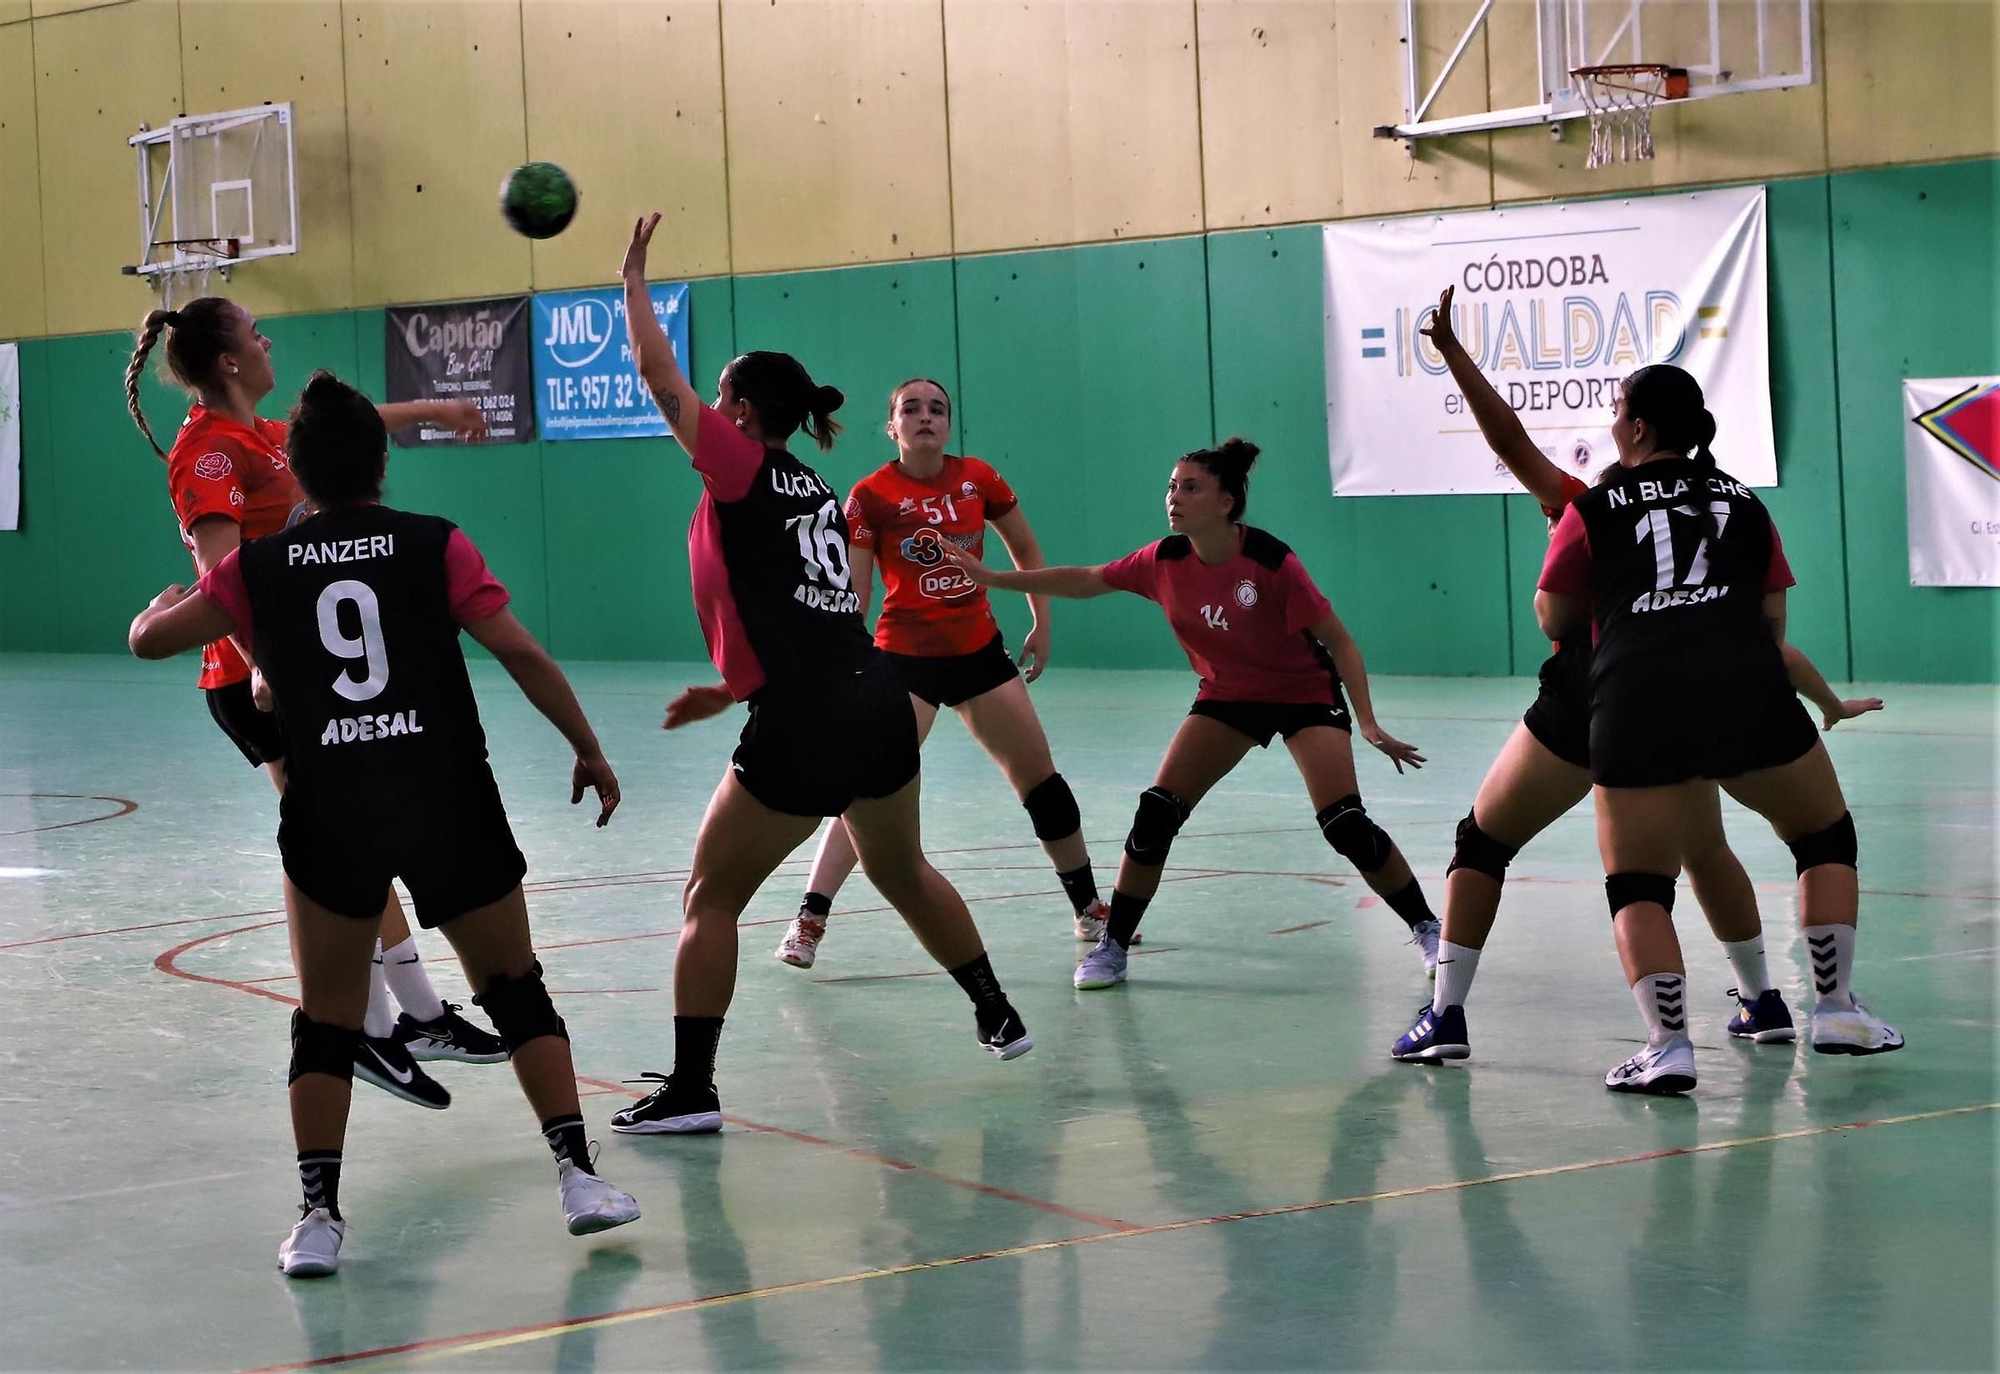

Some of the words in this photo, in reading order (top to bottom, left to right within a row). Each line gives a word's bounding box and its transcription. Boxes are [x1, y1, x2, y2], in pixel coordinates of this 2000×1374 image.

[1463, 253, 1609, 293] CÓRDOBA
[405, 309, 503, 358] Capitão
[545, 305, 603, 347] JML
[468, 350, 494, 380] Grill
[546, 378, 580, 411] TLF:
[582, 375, 609, 409] 957
[614, 374, 634, 408] 32
[1507, 377, 1624, 412] DEPORT
[921, 494, 957, 525] 51
[1607, 486, 1634, 509] N.
[1639, 478, 1752, 501] BLACHE
[287, 534, 394, 566] PANZERI
[784, 499, 850, 590] 16
[1634, 500, 1731, 592] 17
[1200, 604, 1229, 631] 14
[316, 579, 390, 701] 9
[321, 709, 424, 746] ADESAL
